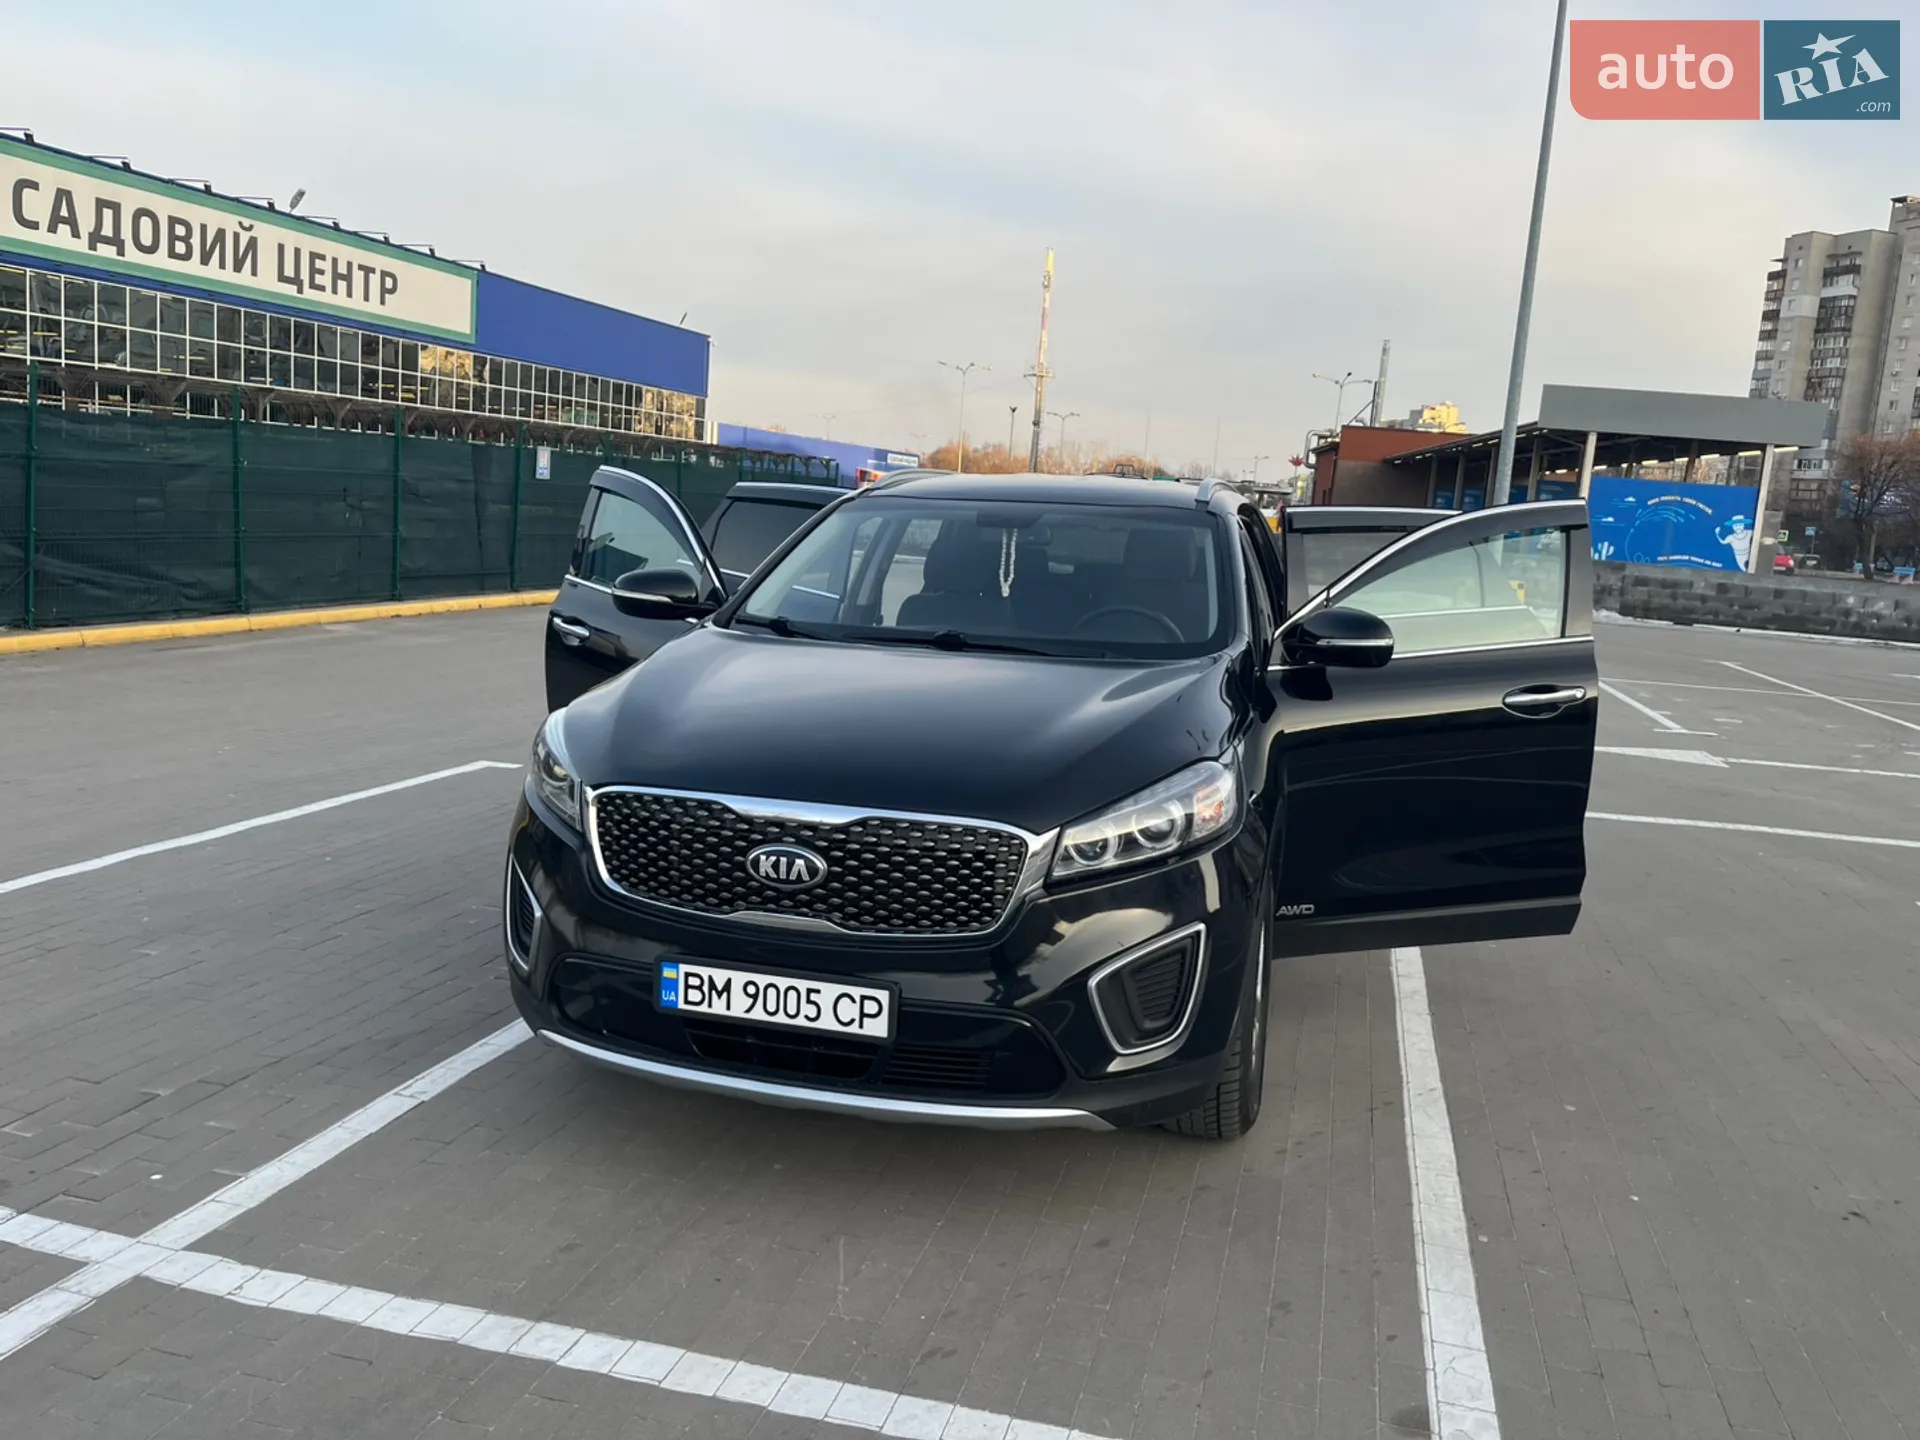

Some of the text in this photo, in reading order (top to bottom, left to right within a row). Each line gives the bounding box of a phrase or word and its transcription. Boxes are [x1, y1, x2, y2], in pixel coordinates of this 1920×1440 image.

[12, 177, 399, 306] САДОВИЙ ЦЕНТР
[759, 854, 811, 881] KIA
[1275, 904, 1315, 916] AWD
[662, 990, 676, 1002] UA
[683, 971, 884, 1029] BM 9005 CP
